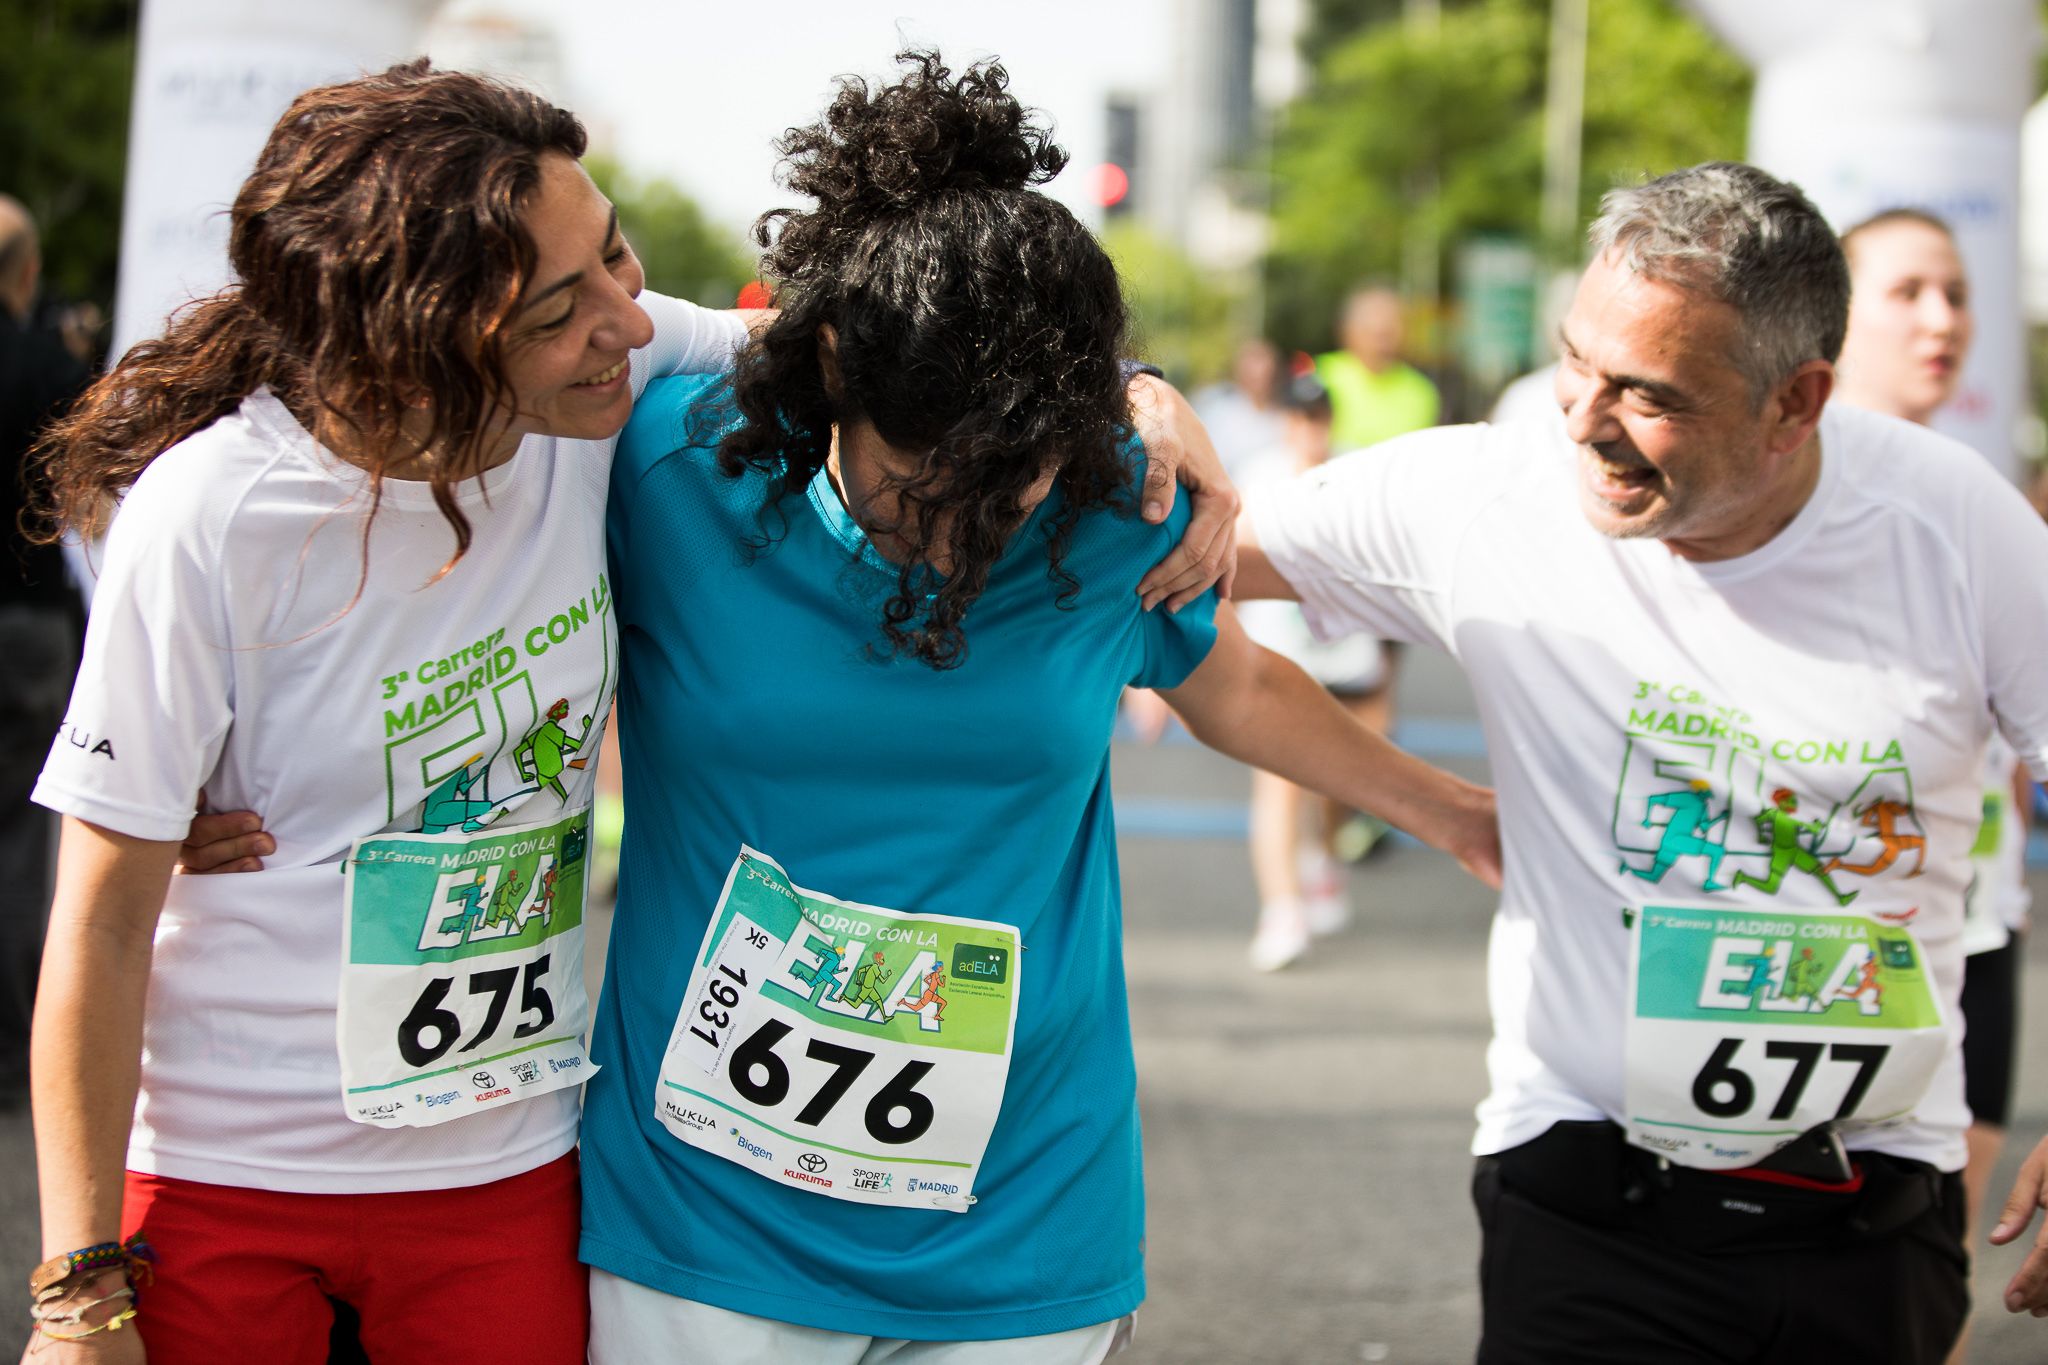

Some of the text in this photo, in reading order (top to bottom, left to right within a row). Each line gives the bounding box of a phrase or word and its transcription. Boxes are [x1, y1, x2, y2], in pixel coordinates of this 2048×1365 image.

[384, 572, 608, 738] MADRID CON LA
[417, 627, 506, 685] Carrera
[1627, 706, 1904, 764] MADRID CON LA
[385, 851, 437, 865] Carrera
[440, 846, 505, 869] MADRID
[508, 839, 538, 858] CON
[538, 835, 556, 850] LA
[416, 853, 554, 952] ELA
[762, 877, 799, 904] Carrera
[875, 926, 913, 944] CON
[916, 929, 939, 947] LA
[744, 926, 769, 951] 5K
[1716, 919, 1796, 937] MADRID
[1801, 923, 1842, 938] CON
[1844, 926, 1868, 938] LA
[767, 925, 942, 1033] ELA
[959, 960, 999, 976] adELA
[1697, 937, 1881, 1016] ELA
[397, 953, 555, 1067] 675
[690, 964, 748, 1049] 1931
[509, 1061, 533, 1075] SPORT
[518, 1071, 535, 1082] LIFE
[557, 1056, 581, 1069] MADRID
[728, 1017, 935, 1145] 676
[1692, 1037, 1891, 1121] 677
[425, 1090, 462, 1108] Biogen
[666, 1101, 716, 1129] MUKUA
[737, 1135, 773, 1161] Biogen
[852, 1168, 886, 1180] SPORT
[854, 1178, 880, 1190] LIFE
[918, 1182, 958, 1195] MADRID
